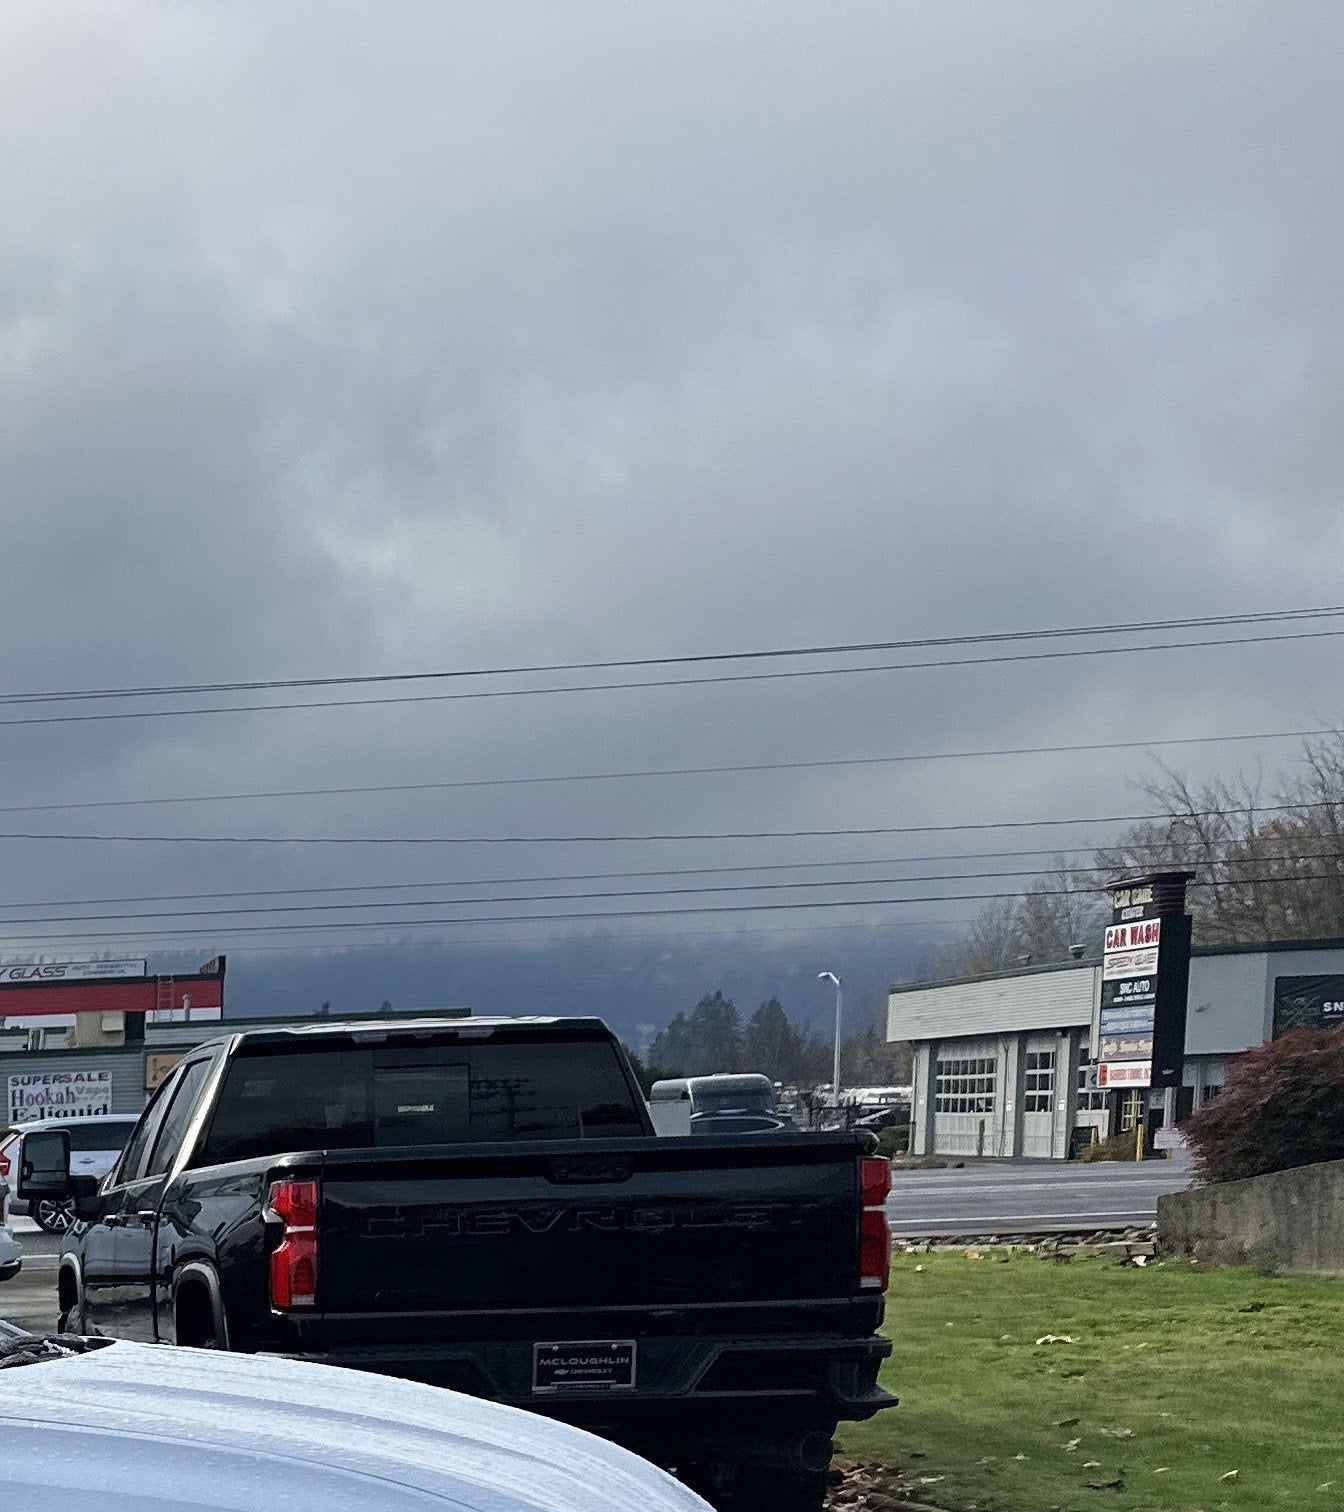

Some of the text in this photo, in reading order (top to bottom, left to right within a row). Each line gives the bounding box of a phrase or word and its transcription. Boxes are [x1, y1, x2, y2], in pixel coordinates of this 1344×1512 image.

[1106, 922, 1160, 949] CAR WASH
[9, 965, 69, 980] GLASS
[11, 1086, 76, 1107] Hookah
[361, 1204, 818, 1239] CHEVROLET
[539, 1357, 630, 1366] MCLOUGHLIN
